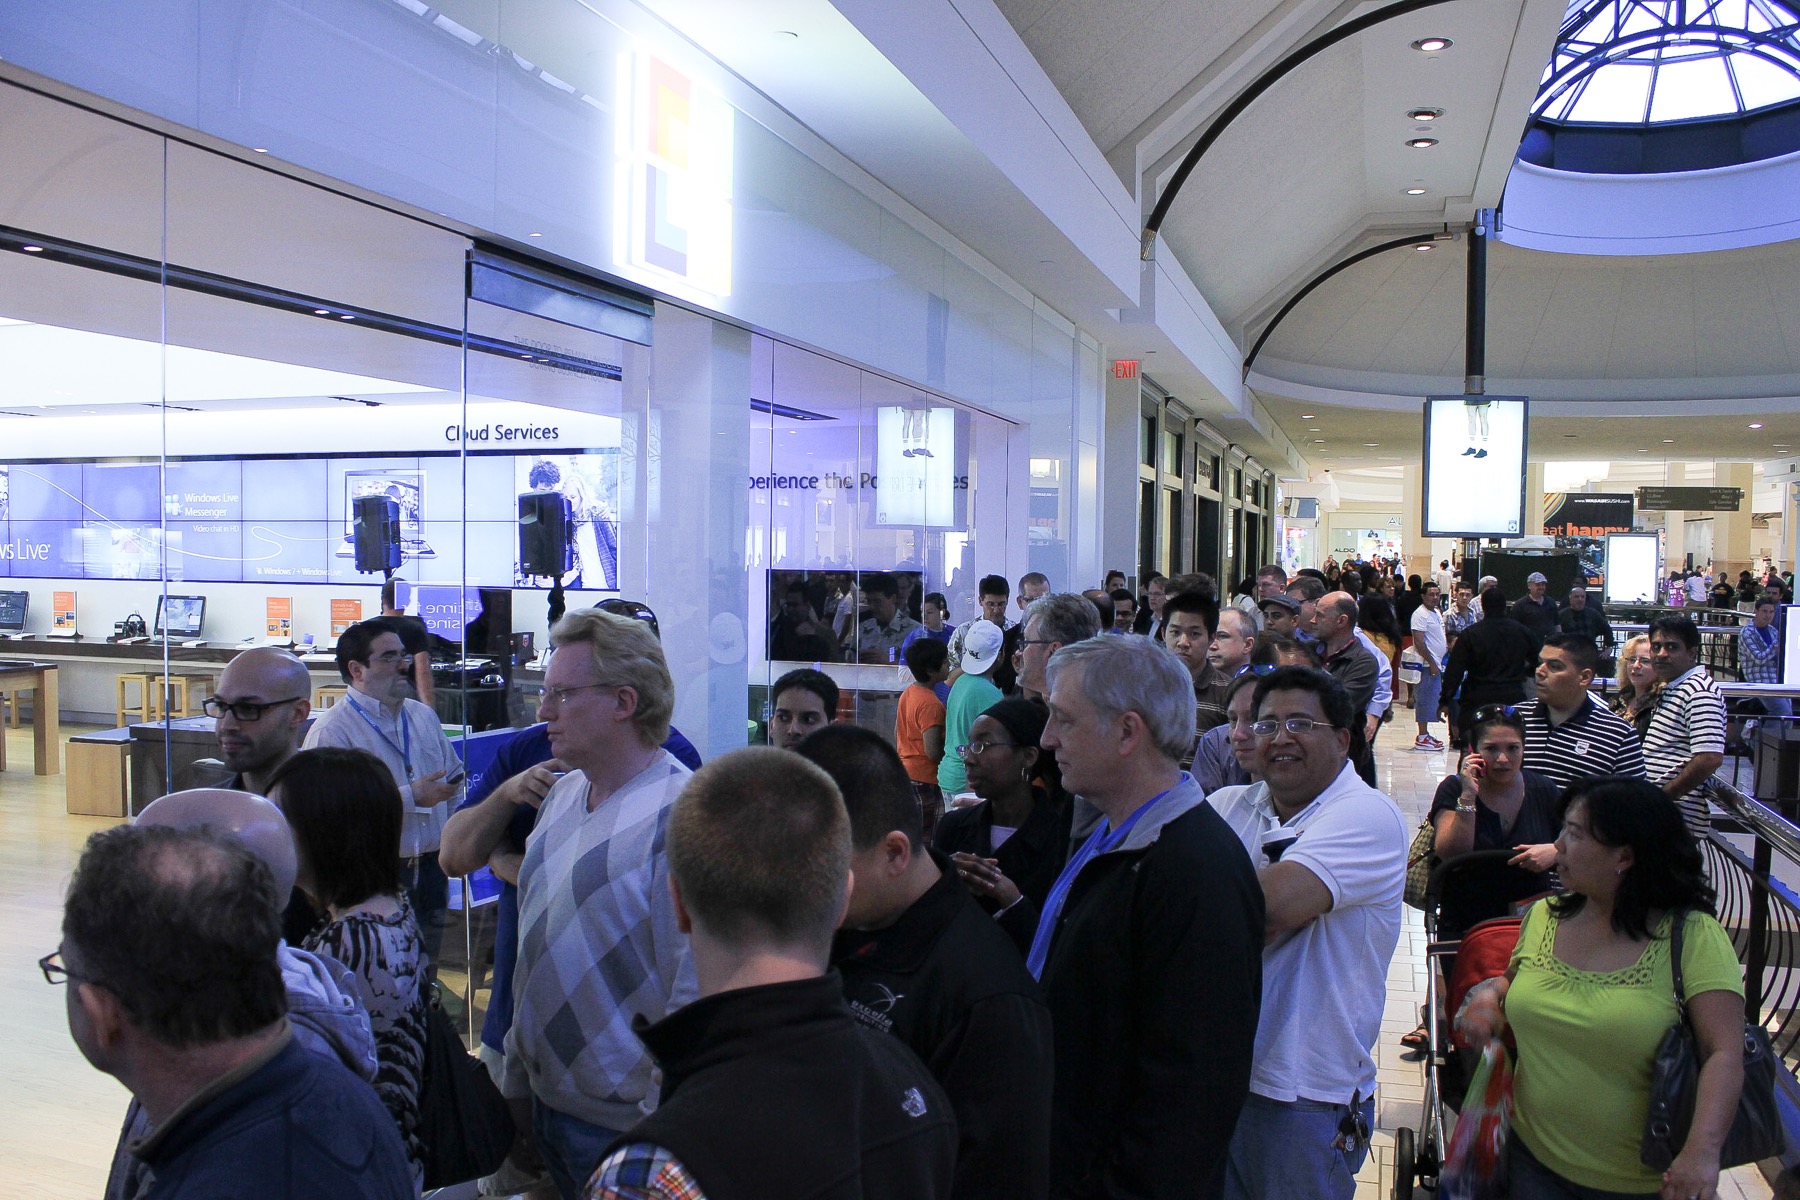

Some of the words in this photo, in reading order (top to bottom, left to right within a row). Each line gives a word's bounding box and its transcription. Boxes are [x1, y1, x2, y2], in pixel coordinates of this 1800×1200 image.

[1115, 361, 1138, 378] EXIT
[445, 424, 489, 442] Cloud
[495, 423, 559, 441] Services
[824, 472, 853, 489] the
[184, 493, 221, 503] Windows
[223, 493, 239, 503] Live
[184, 507, 228, 519] Messenger
[1543, 525, 1563, 536] eat
[17, 538, 49, 561] Live
